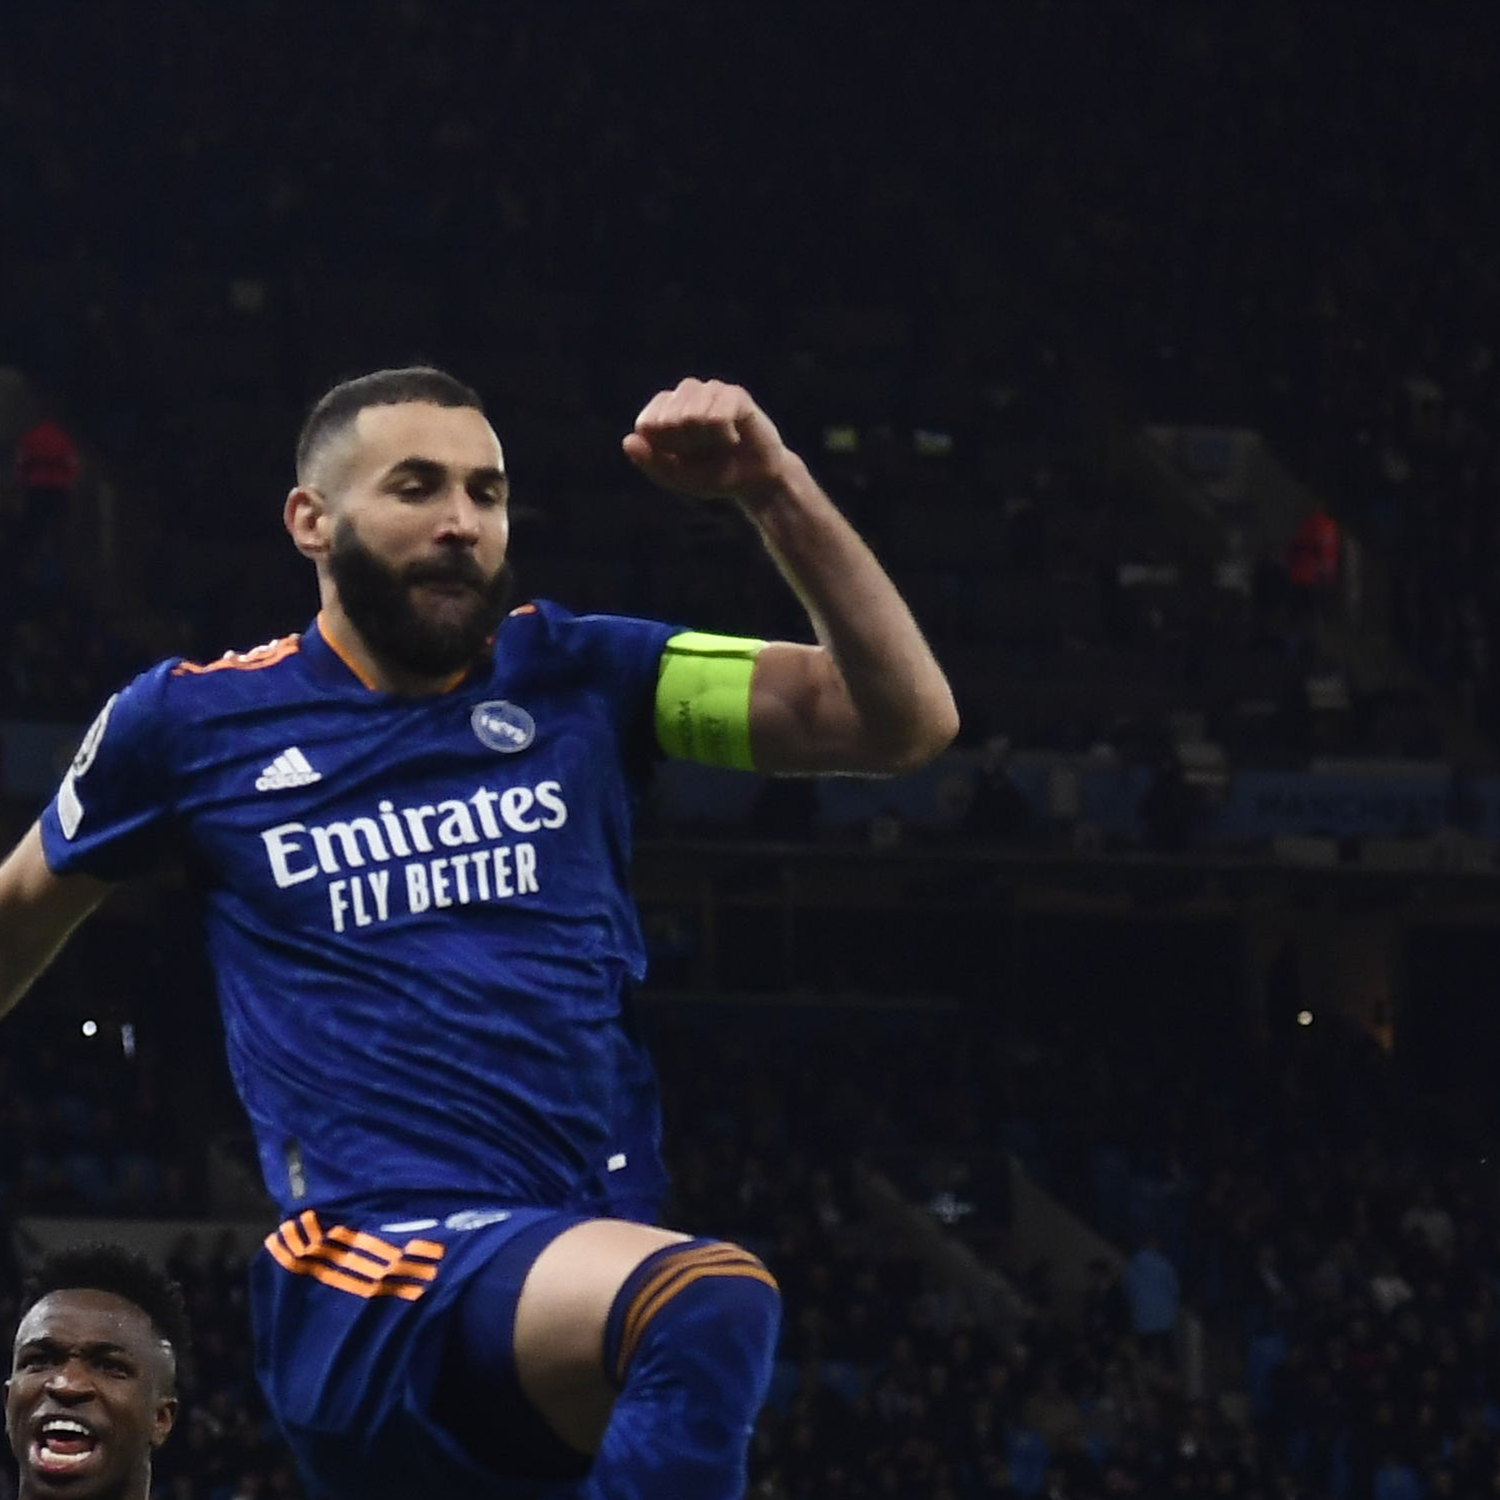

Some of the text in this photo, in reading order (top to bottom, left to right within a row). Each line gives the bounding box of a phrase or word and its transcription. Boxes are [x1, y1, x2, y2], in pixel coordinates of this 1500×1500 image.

[261, 781, 568, 888] Emirates
[329, 842, 540, 933] FLY BETTER
